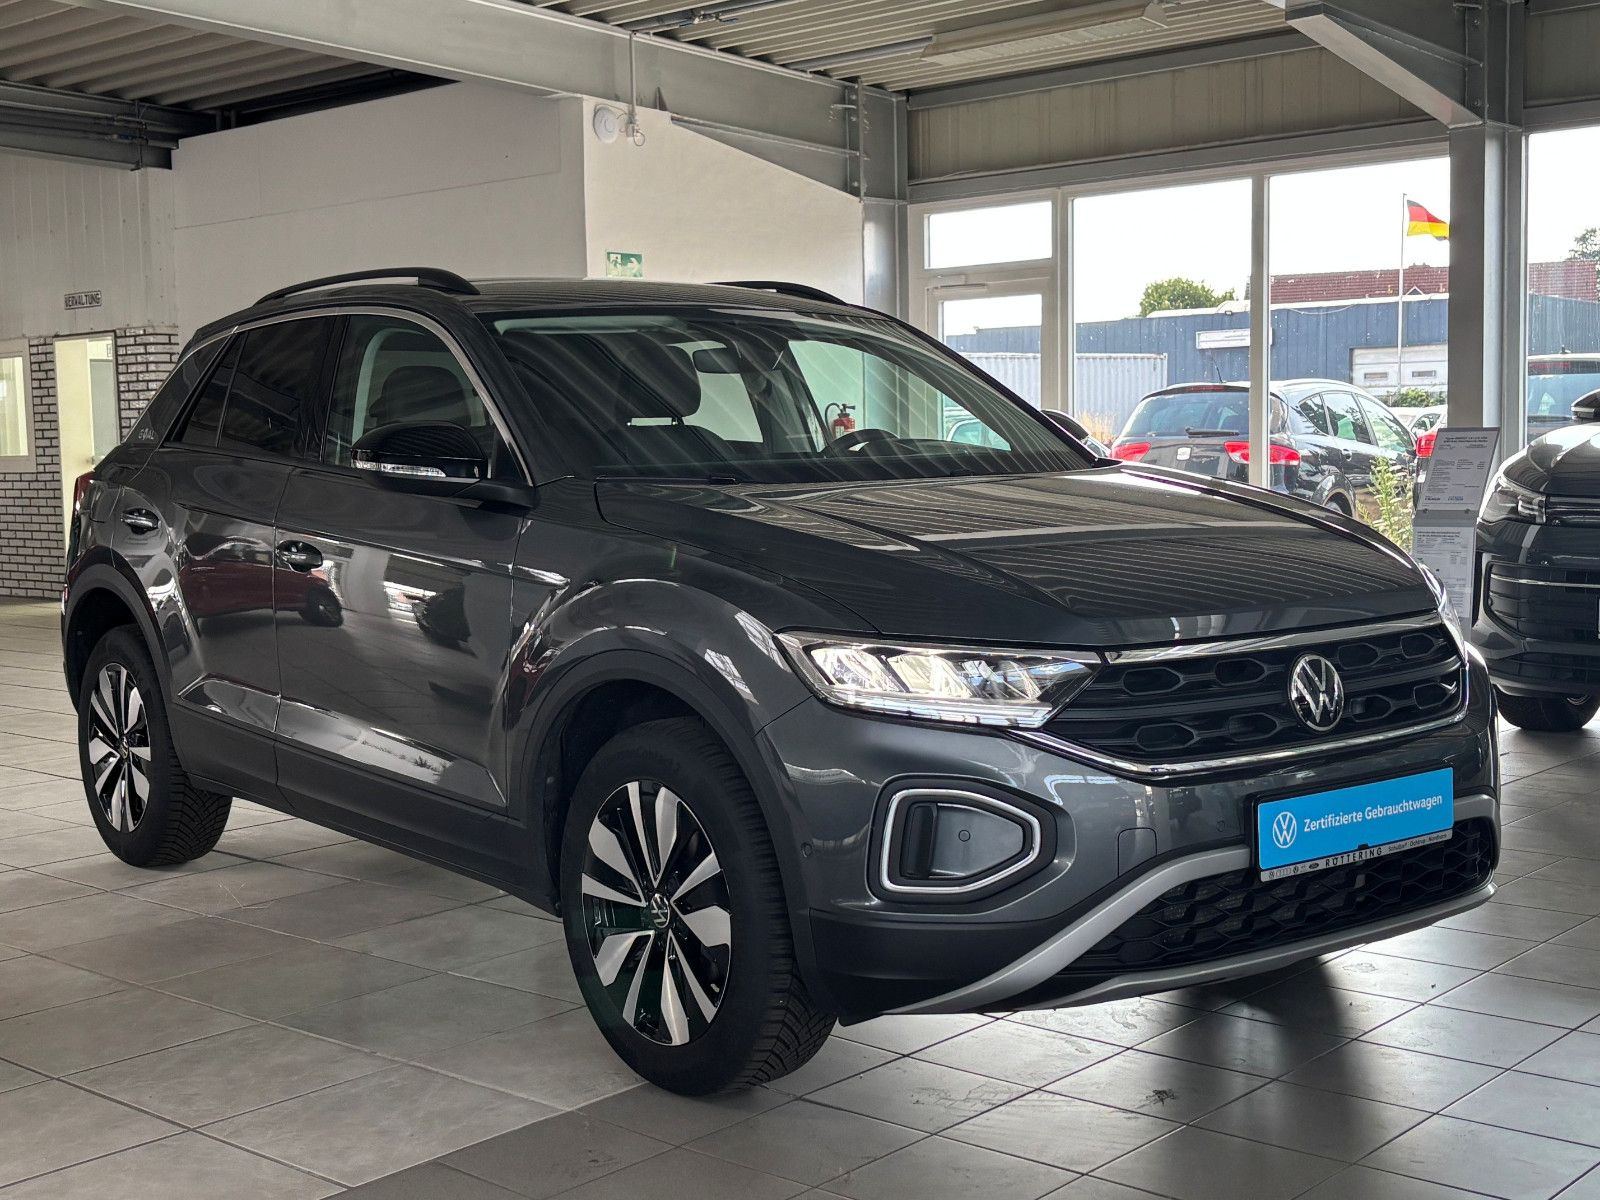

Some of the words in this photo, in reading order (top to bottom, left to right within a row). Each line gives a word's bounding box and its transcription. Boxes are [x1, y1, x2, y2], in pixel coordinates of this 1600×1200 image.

[65, 293, 100, 307] VERWALTUNG
[1304, 811, 1363, 832] Zertifizierte
[1365, 794, 1443, 820] Gebrauchtwagen
[1325, 848, 1382, 867] RÖTTERING
